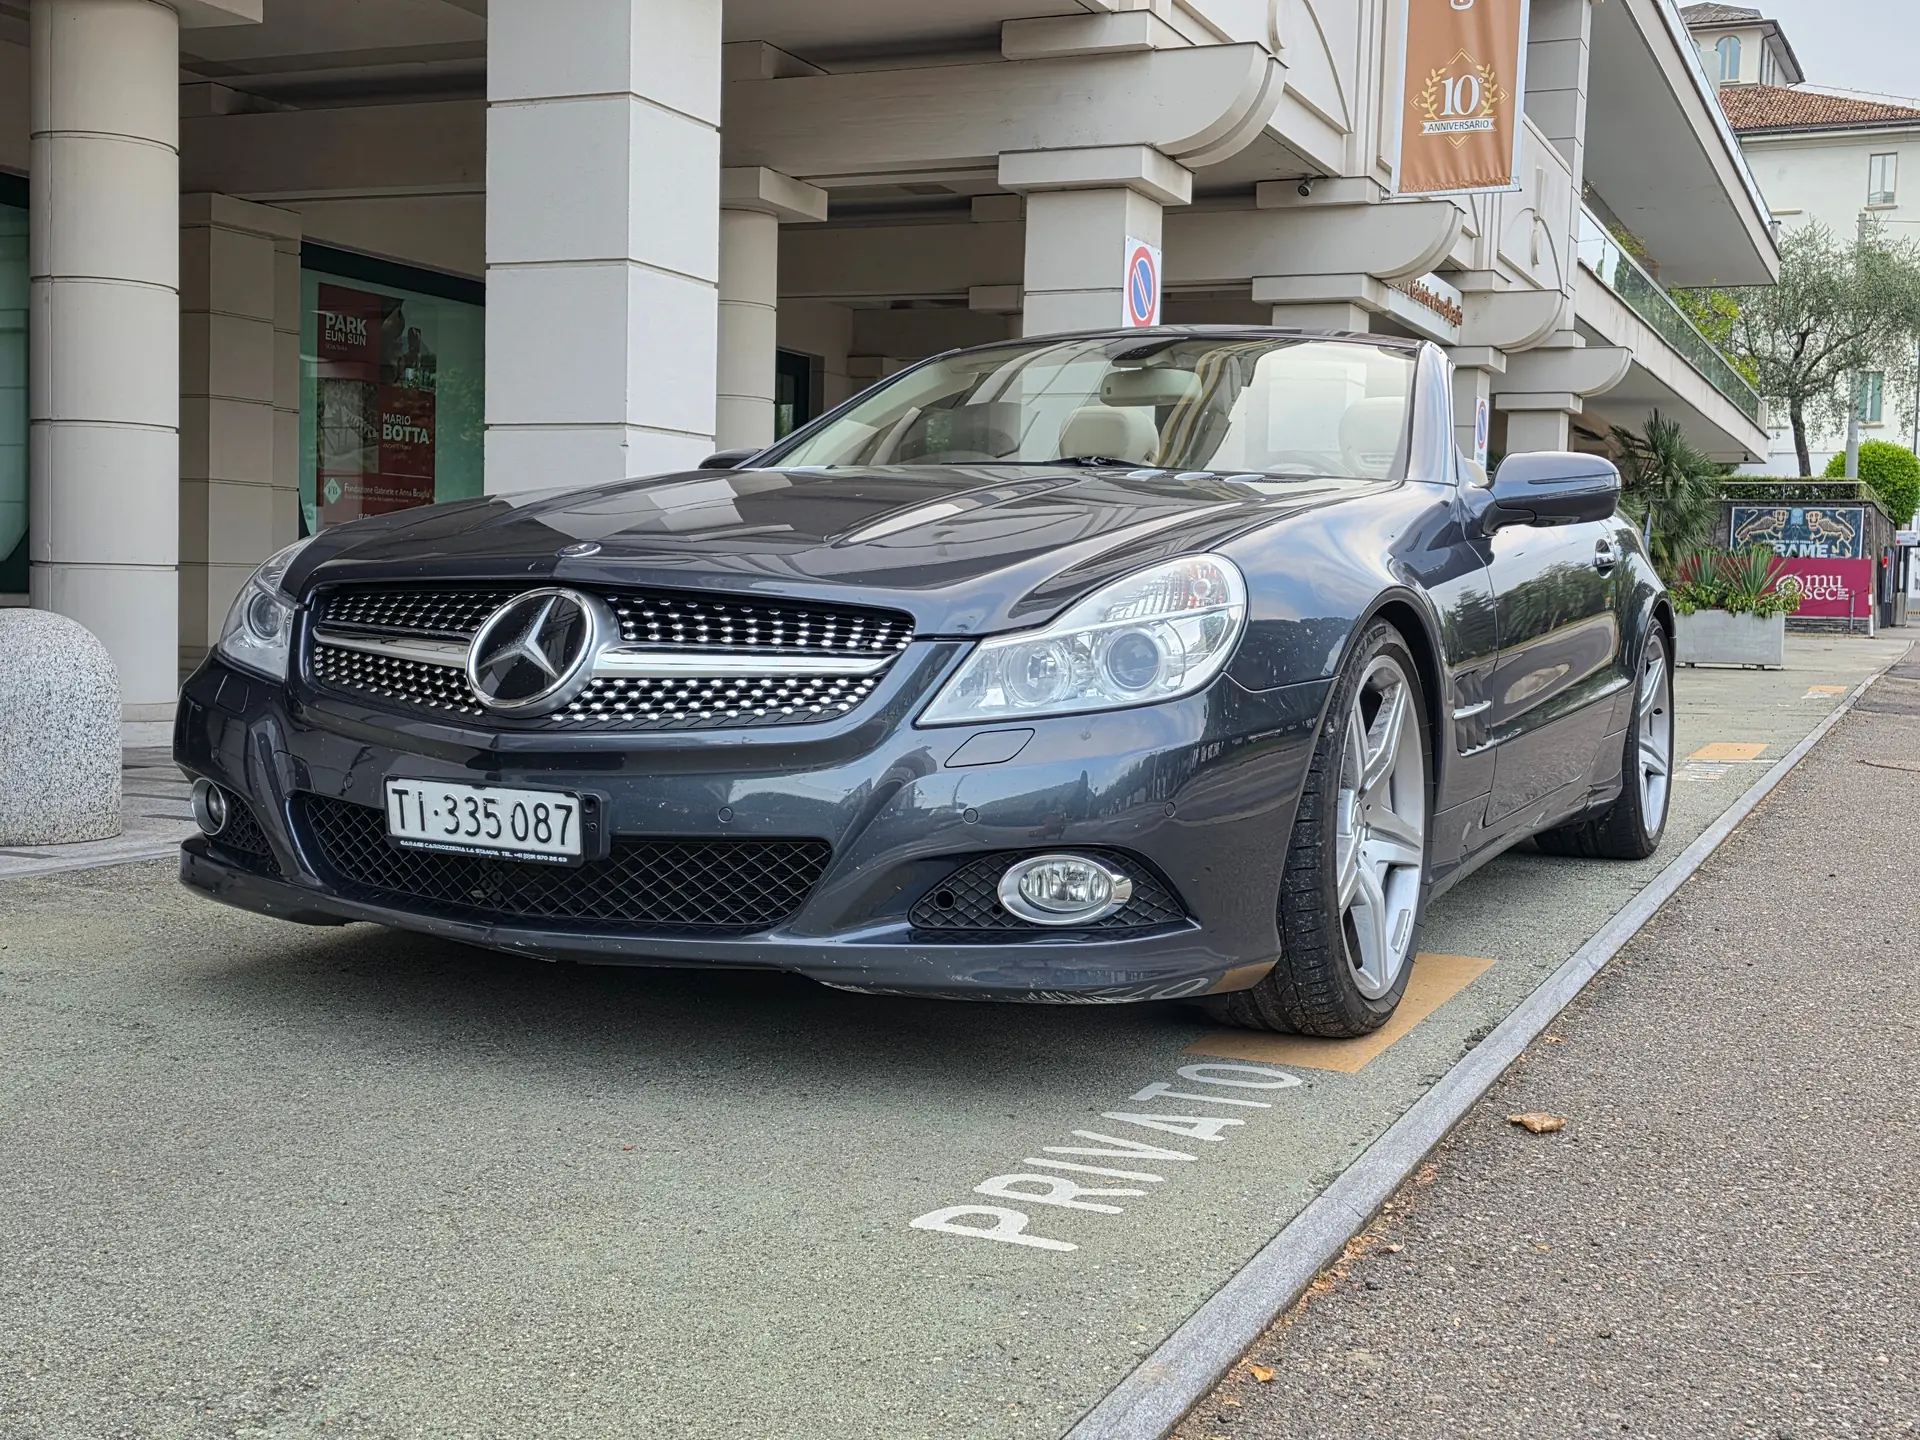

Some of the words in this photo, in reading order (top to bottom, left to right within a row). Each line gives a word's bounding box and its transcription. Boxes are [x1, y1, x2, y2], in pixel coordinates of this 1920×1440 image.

[1427, 119, 1489, 132] ANNIVERSARIO
[325, 313, 367, 335] PARK
[325, 330, 345, 342] EUN
[347, 334, 366, 346] SUN
[382, 412, 411, 425] MARIO
[382, 424, 430, 444] BOTTA
[344, 482, 373, 494] Fondazione
[374, 486, 394, 496] Gabriele
[399, 488, 412, 496] Anna
[412, 488, 430, 499] Braglia
[1806, 574, 1843, 588] mu
[1805, 586, 1837, 600] sec
[510, 799, 573, 846] 087
[399, 840, 424, 848] GARAGE
[424, 842, 465, 852] CARROZZERIA
[908, 1063, 1302, 1252] PRIVATO
